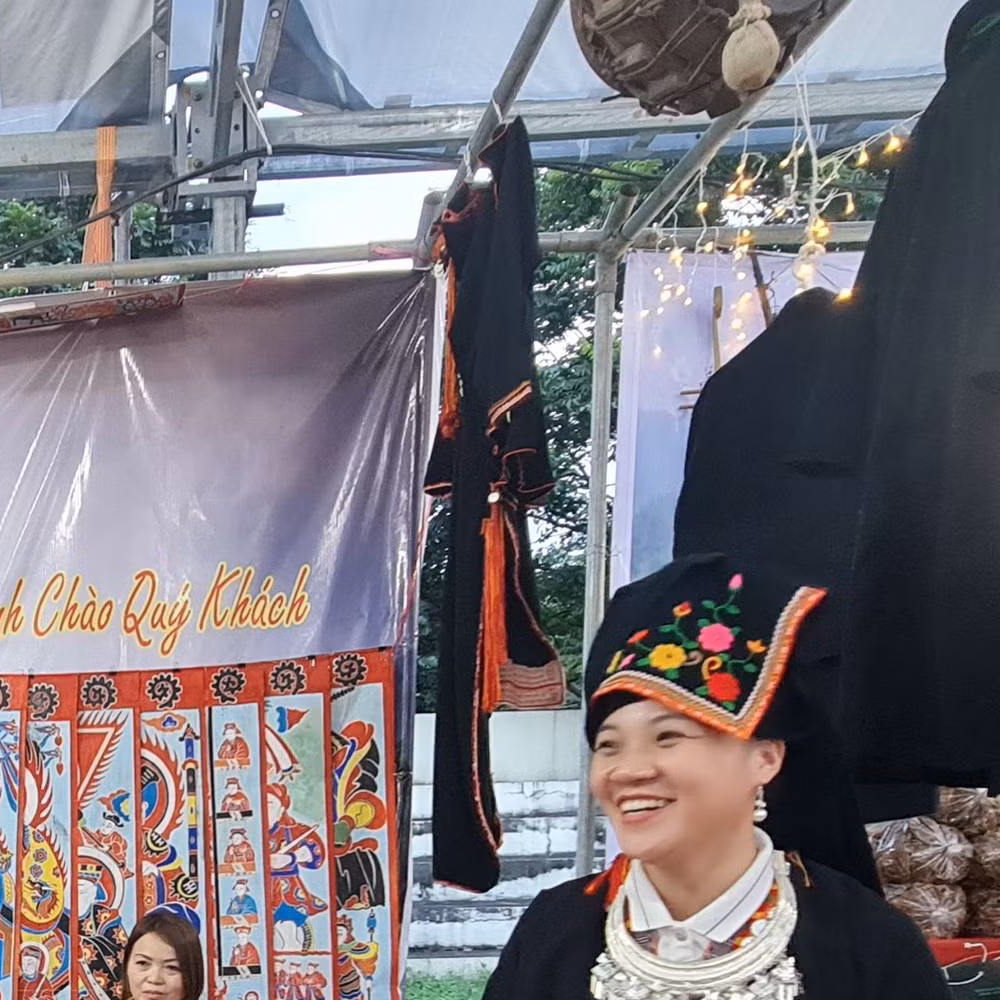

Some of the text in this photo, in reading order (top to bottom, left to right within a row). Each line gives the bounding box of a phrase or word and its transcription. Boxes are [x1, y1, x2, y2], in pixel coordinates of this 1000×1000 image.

[32, 571, 113, 638] Chào
[122, 568, 191, 658] Quý
[198, 560, 311, 634] Khách
